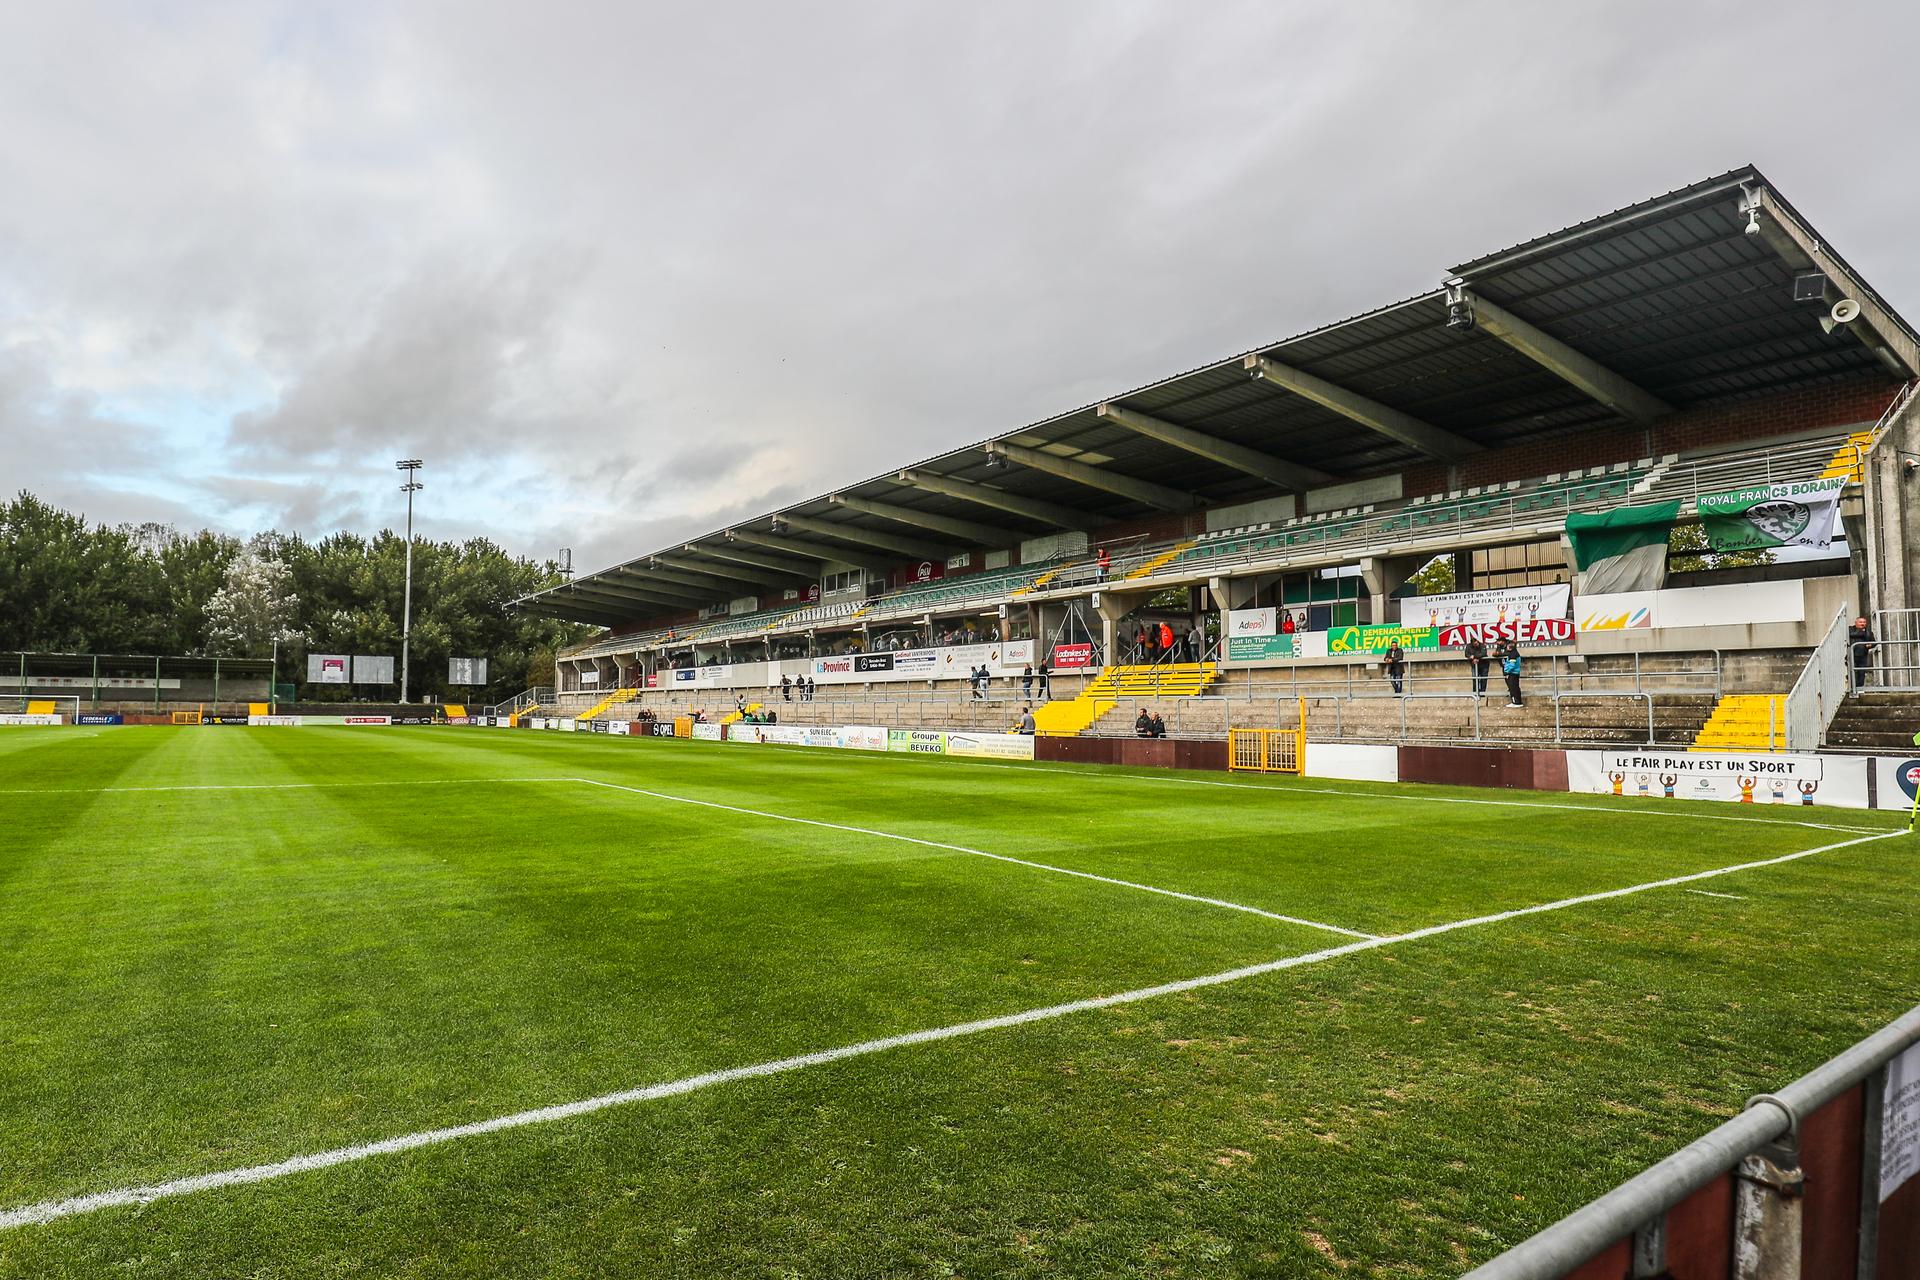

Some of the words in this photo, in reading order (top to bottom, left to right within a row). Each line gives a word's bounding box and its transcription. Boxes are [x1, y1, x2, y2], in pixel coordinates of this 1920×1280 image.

[1700, 494, 1737, 506] ROYAL
[1739, 487, 1789, 502] FRANCS
[1238, 620, 1262, 631] Adeps
[1362, 627, 1431, 637] DEMENAGEMENTS
[1447, 618, 1572, 646] ANSSEAU
[1355, 633, 1431, 651] LEMORT
[659, 724, 674, 736] OPEL
[809, 728, 820, 736] SUN
[821, 728, 832, 736] ELEC
[911, 731, 940, 741] Groupe
[910, 743, 941, 753] BEVEKO
[1616, 758, 1629, 767] LE
[1632, 757, 1660, 769] FAIR
[1664, 758, 1695, 770] PLAY
[1698, 760, 1723, 771] EST
[1727, 761, 1745, 771] UN
[1749, 760, 1796, 774] SPORT
